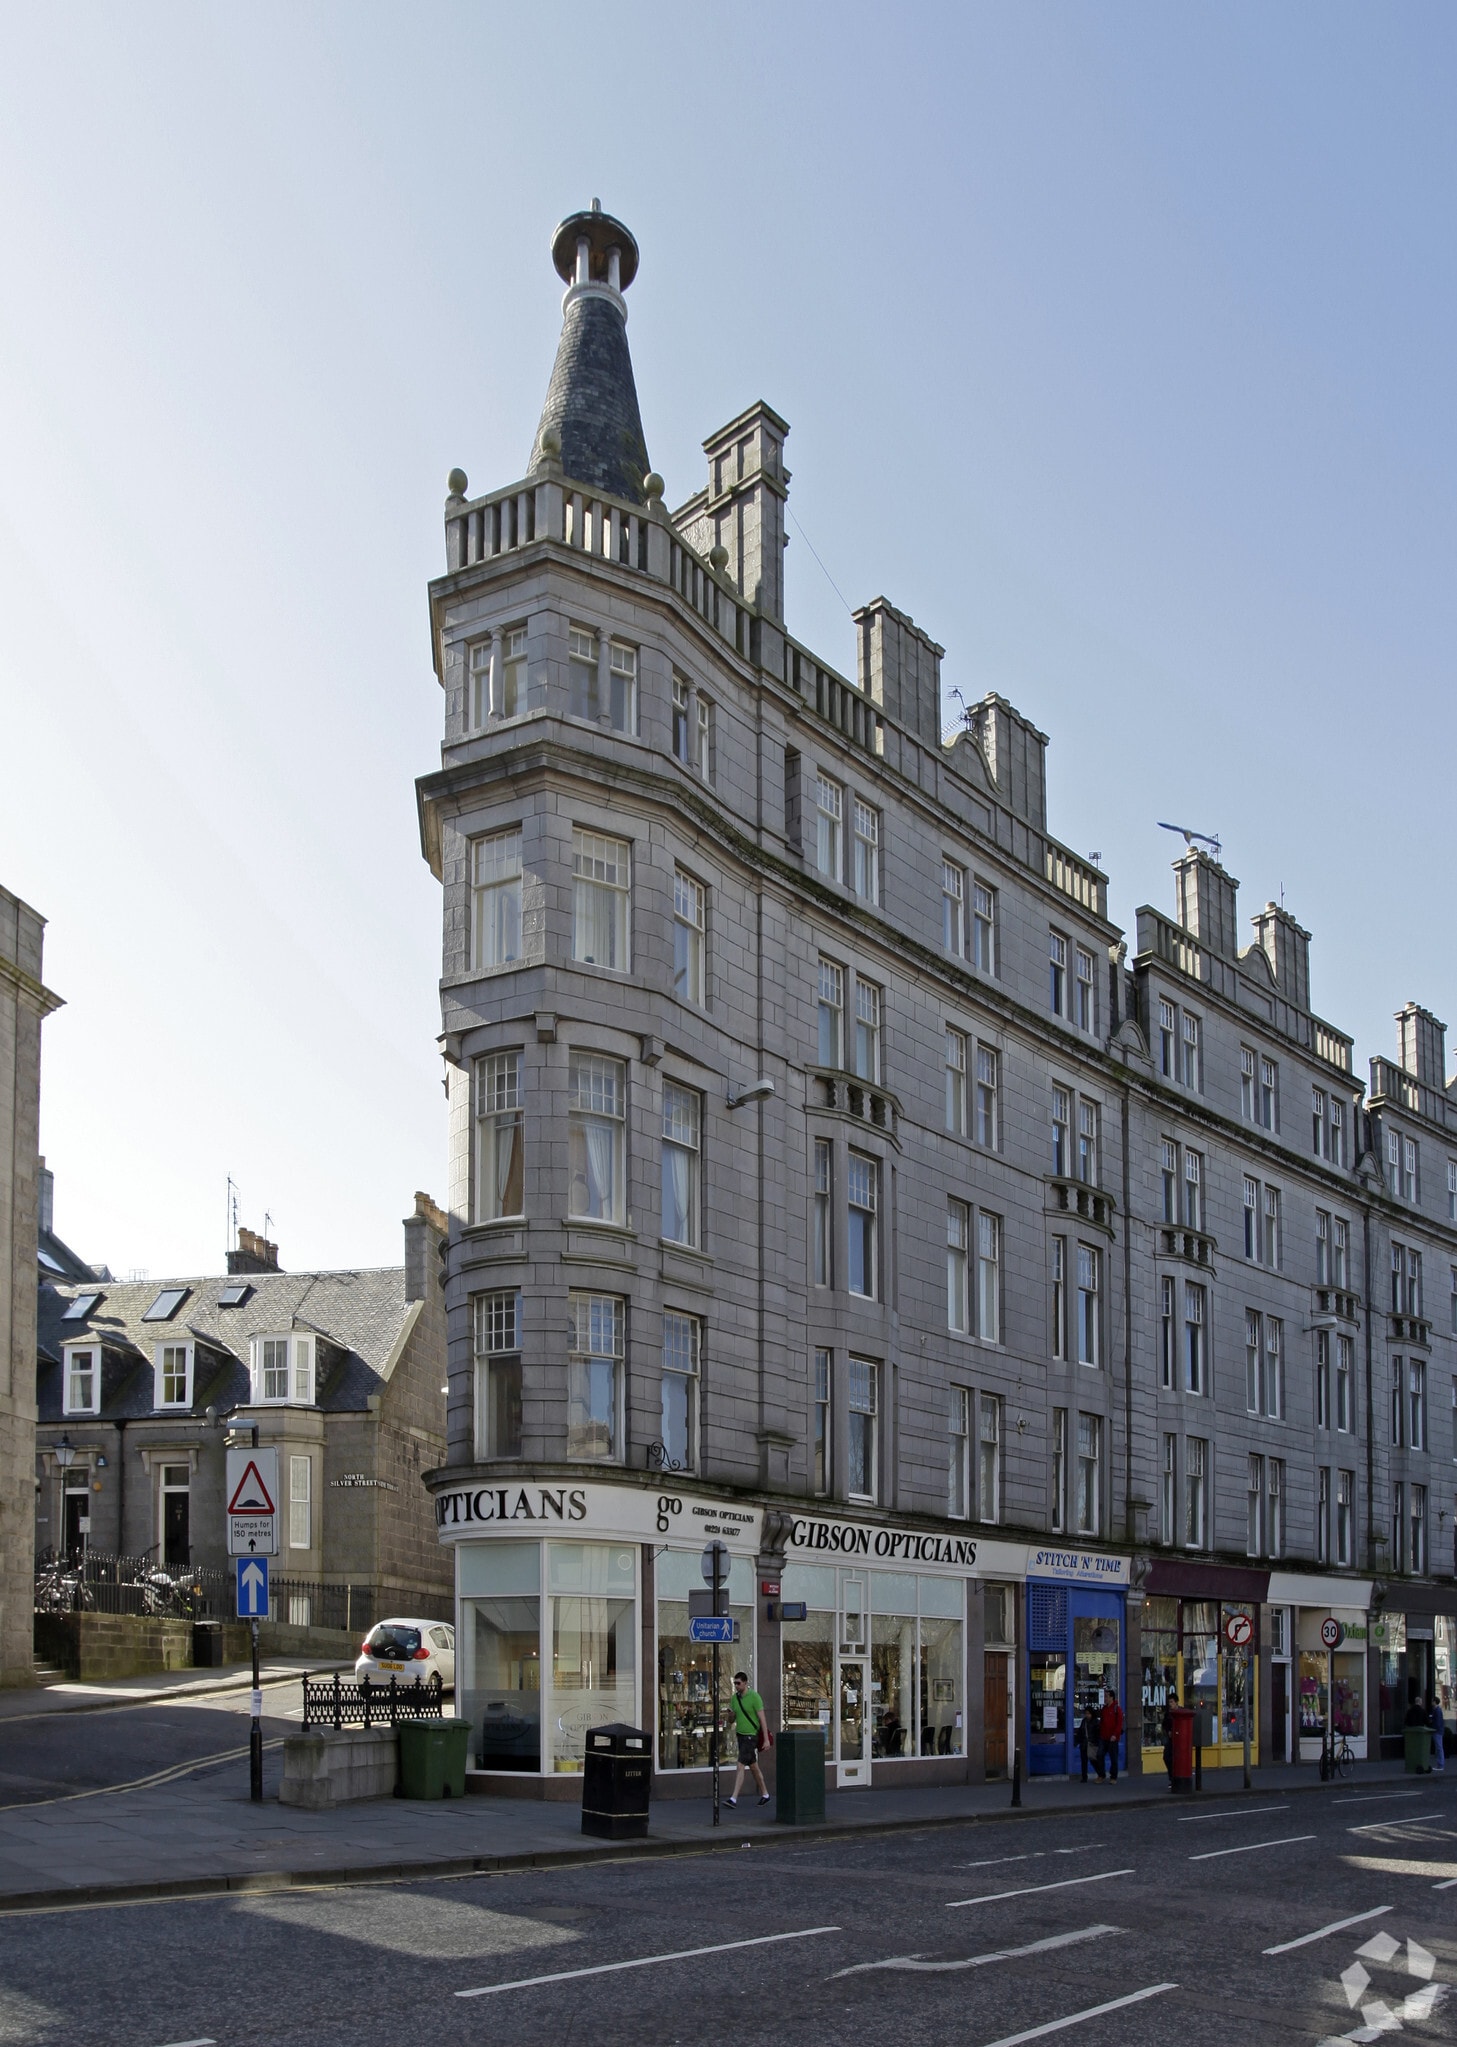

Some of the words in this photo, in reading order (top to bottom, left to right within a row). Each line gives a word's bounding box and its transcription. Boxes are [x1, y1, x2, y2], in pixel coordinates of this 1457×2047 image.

[354, 1479, 377, 1487] STREET
[435, 1488, 587, 1528] OPTICIANS
[657, 1496, 682, 1532] go
[692, 1506, 718, 1518] GIBSON
[719, 1510, 755, 1524] OPTICIANS
[234, 1521, 258, 1529] Humps
[790, 1520, 872, 1554] GIBSON
[874, 1531, 977, 1566] OPTICIANS
[1036, 1551, 1078, 1568] STITCH
[1095, 1558, 1121, 1573] TIME
[696, 1622, 720, 1630] Unitarian
[1324, 1626, 1337, 1638] 30
[1142, 1685, 1166, 1706] PLAN
[576, 1712, 609, 1721] GIBON
